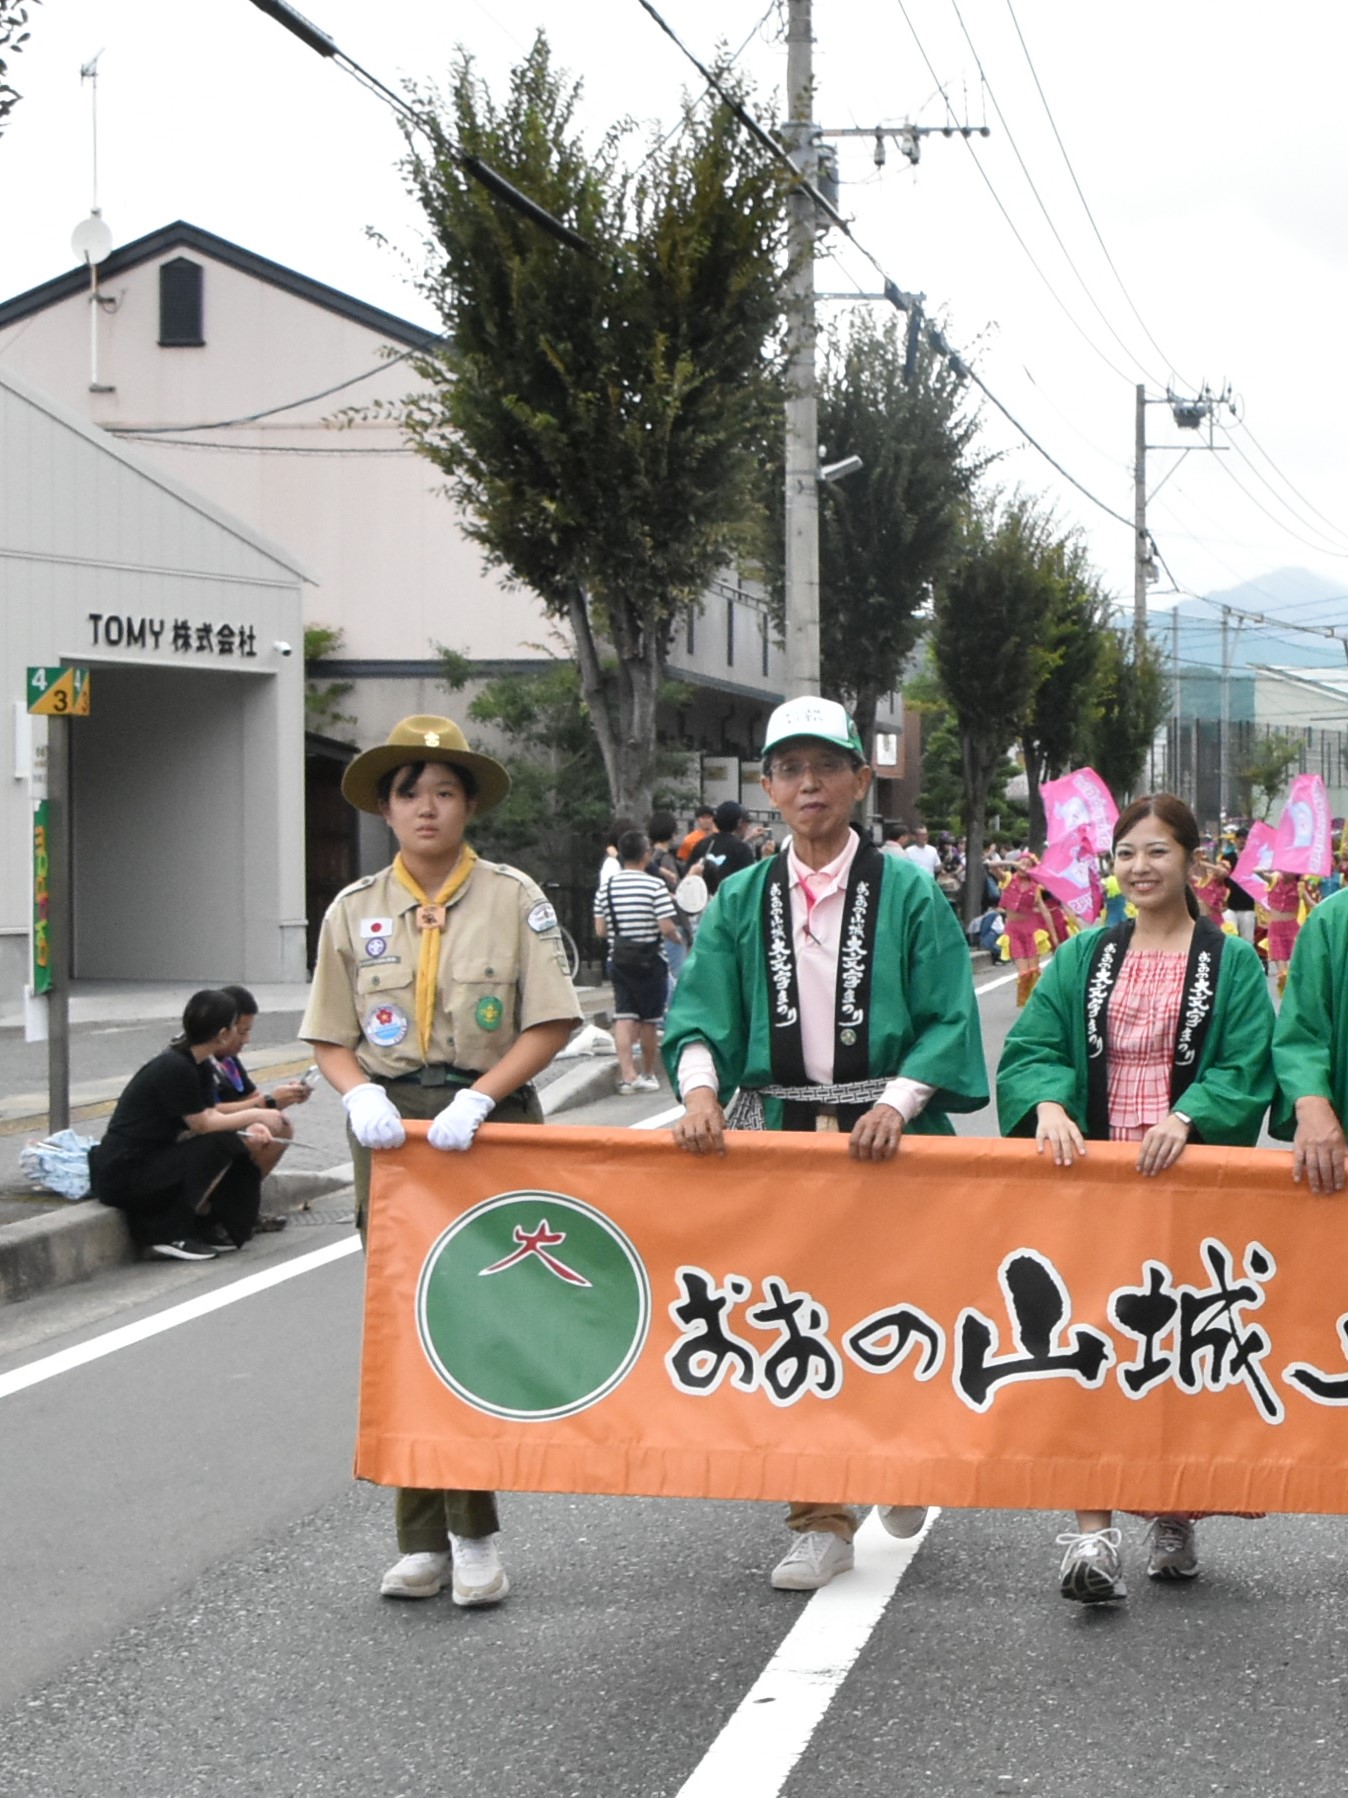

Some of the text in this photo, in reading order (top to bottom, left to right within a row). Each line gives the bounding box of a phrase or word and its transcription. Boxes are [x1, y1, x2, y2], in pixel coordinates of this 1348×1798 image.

[89, 613, 257, 657] TOMY 株式会社
[31, 668, 48, 691] 4
[53, 690, 68, 712] 3
